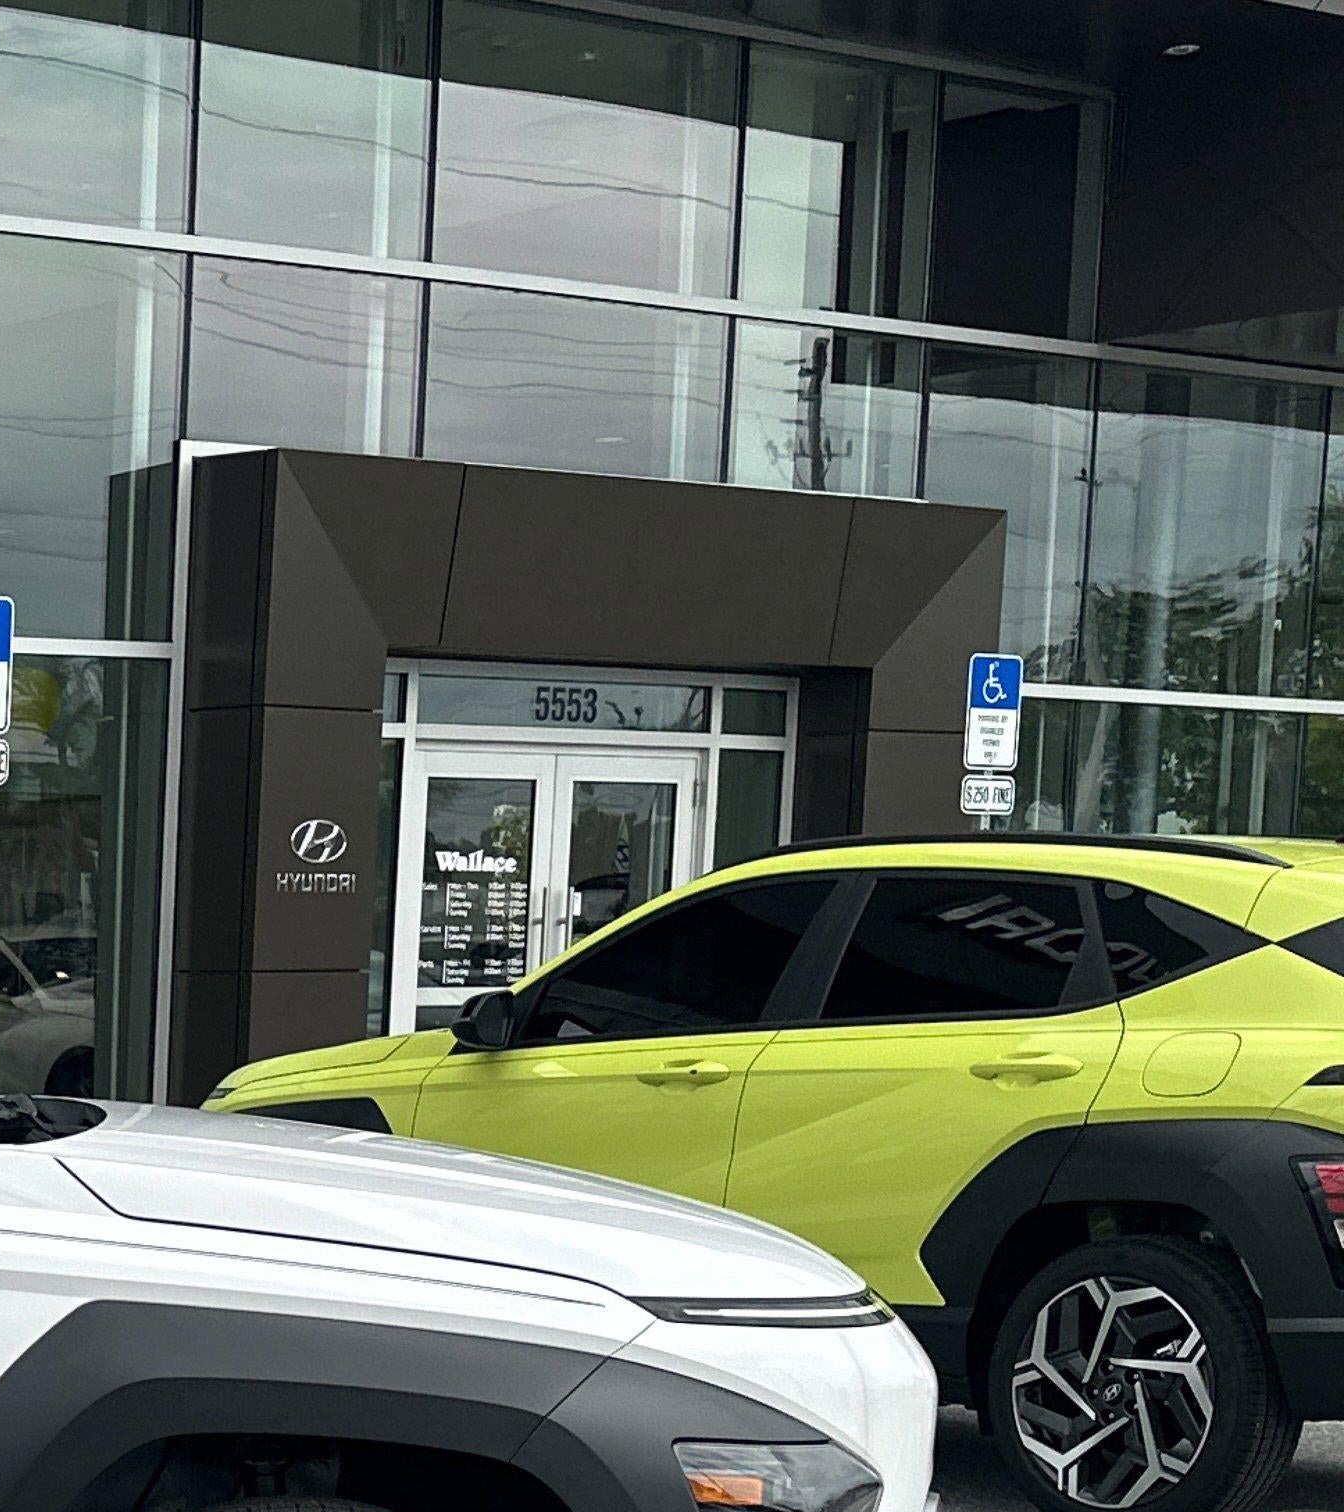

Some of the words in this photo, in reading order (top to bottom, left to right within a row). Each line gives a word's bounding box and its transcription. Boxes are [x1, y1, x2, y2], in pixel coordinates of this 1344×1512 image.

[534, 684, 599, 724] 5553
[434, 848, 518, 873] Wallace
[275, 872, 357, 894] HYUNDAI
